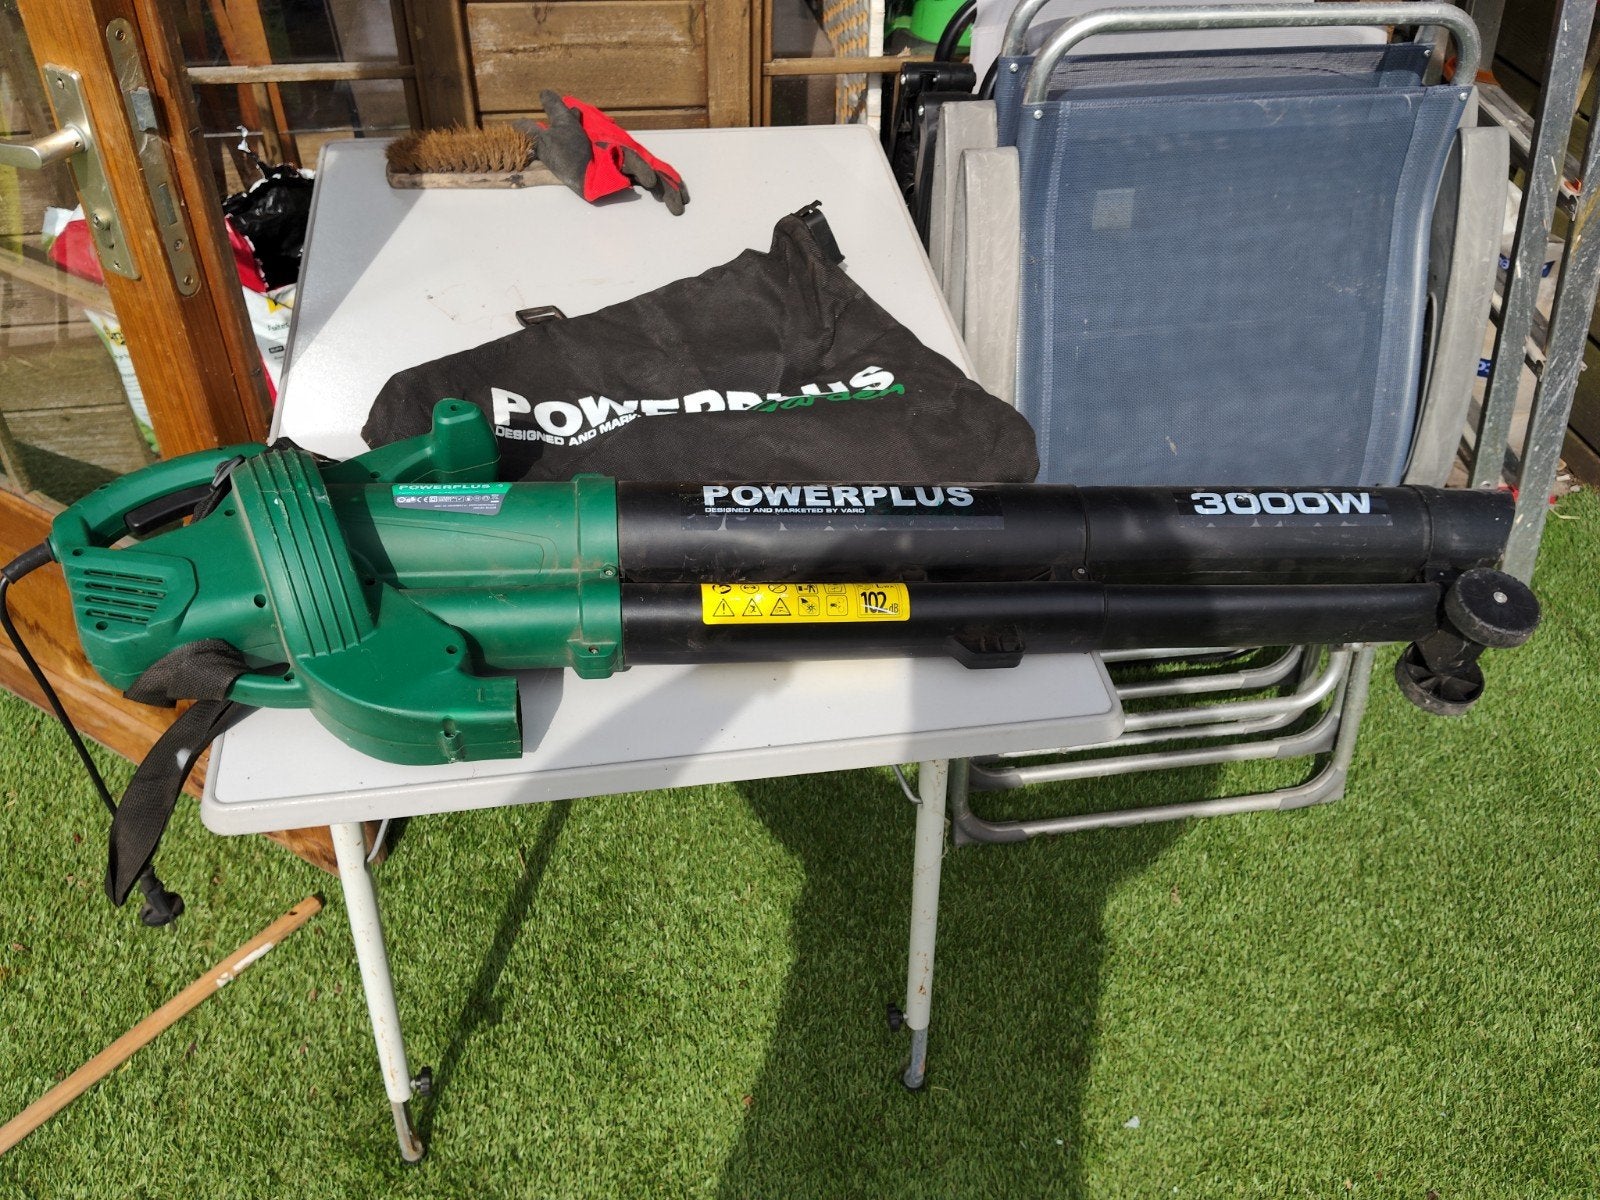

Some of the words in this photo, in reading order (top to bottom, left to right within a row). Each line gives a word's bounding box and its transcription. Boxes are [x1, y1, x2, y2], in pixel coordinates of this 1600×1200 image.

[495, 425, 565, 446] DESIGNED
[568, 428, 598, 447] AND
[702, 485, 974, 507] POWERPLUS
[1191, 492, 1371, 515] 3000W
[860, 591, 888, 614] 102
